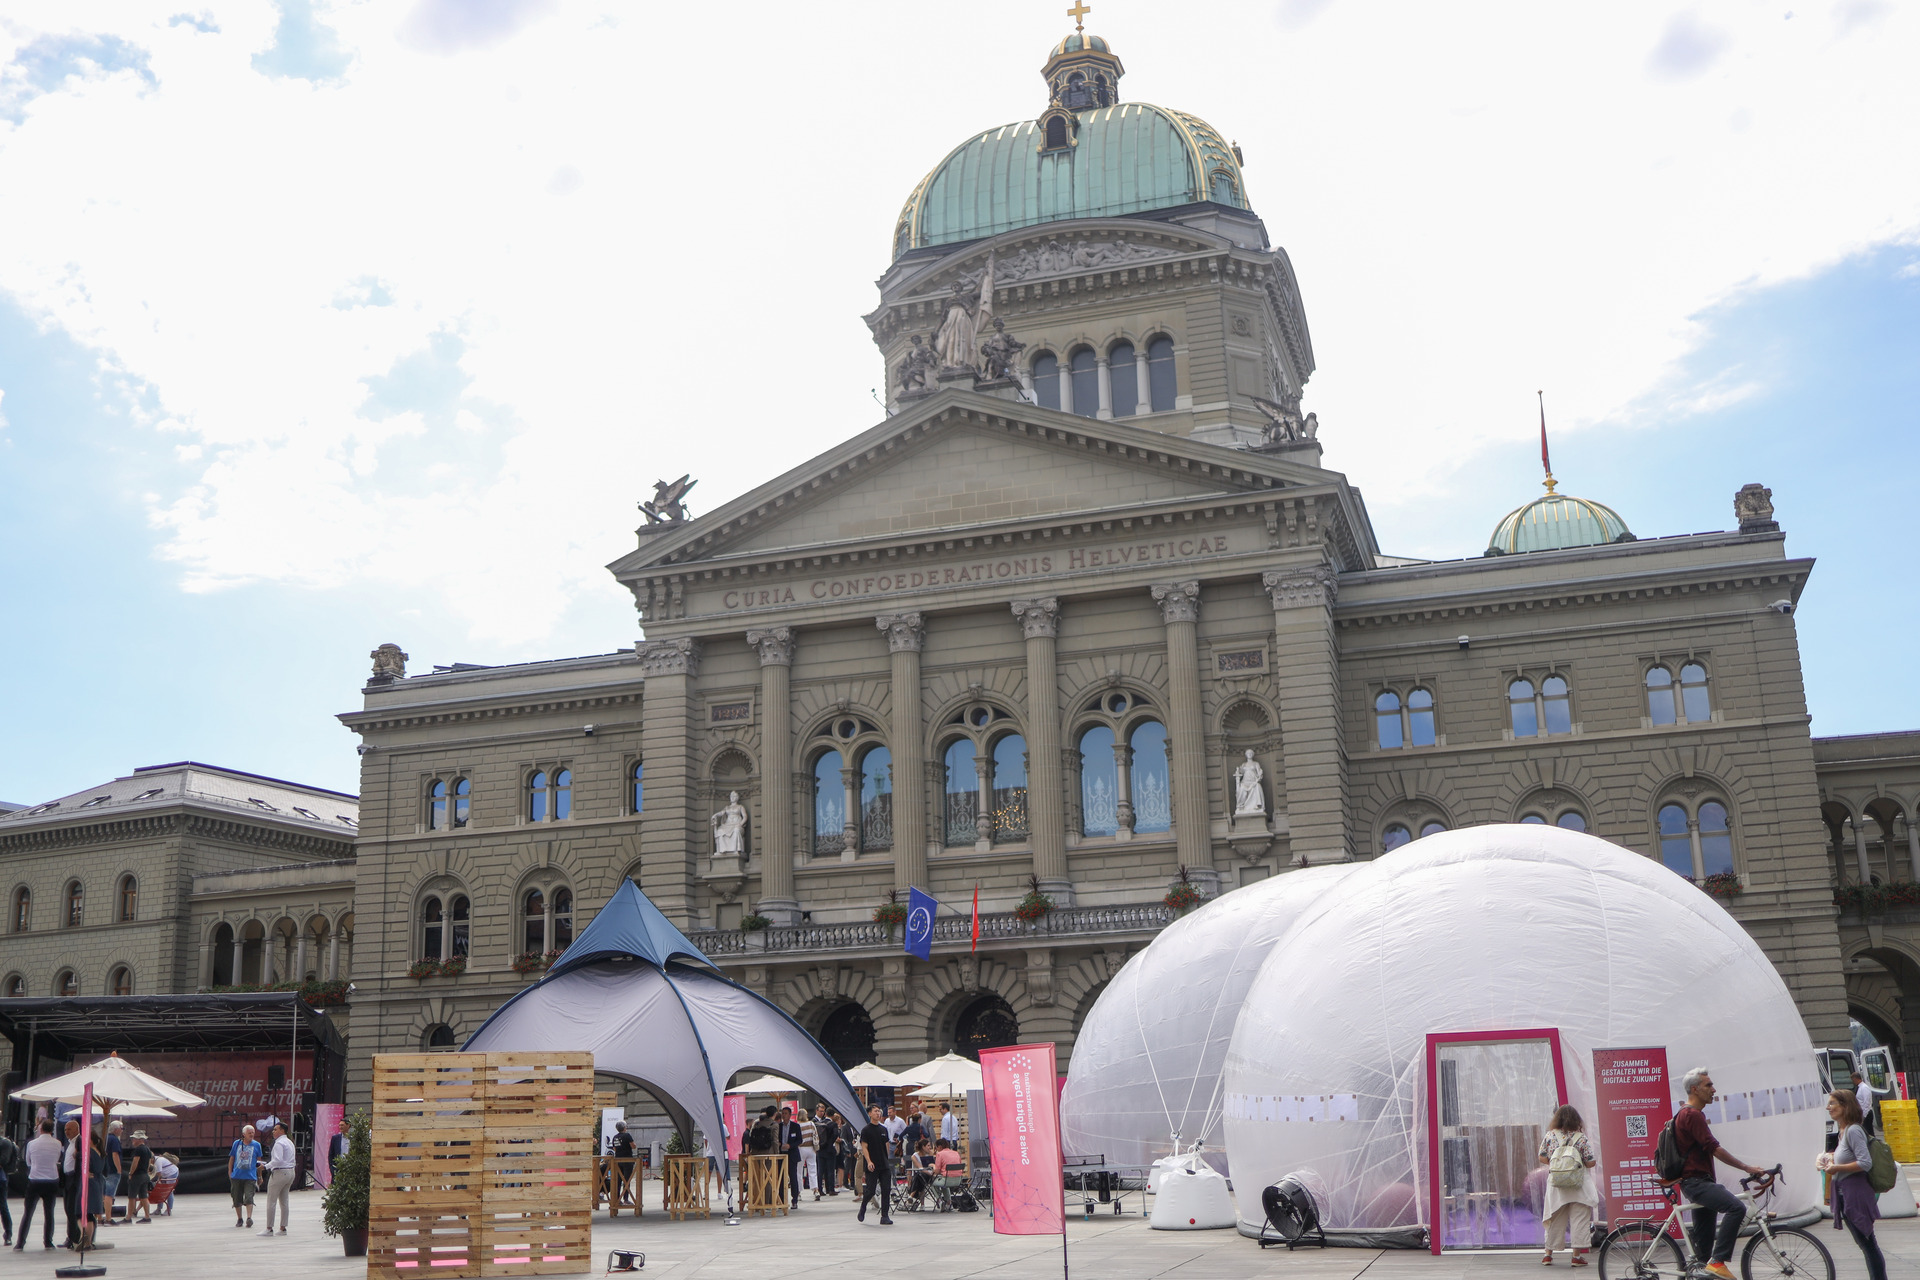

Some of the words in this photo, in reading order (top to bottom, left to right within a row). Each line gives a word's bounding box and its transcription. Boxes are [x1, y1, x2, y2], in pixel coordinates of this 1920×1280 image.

[722, 587, 796, 609] CURIA
[809, 556, 1053, 599] CONFOEDERATIONIS
[1068, 535, 1228, 569] HELVETICAE
[1612, 1060, 1649, 1068] ZUSAMMEN
[1601, 1068, 1637, 1076] GESTALTEN
[1603, 1076, 1631, 1084] DIGITALE
[1632, 1075, 1662, 1083] ZUKUNFT
[243, 1079, 264, 1091] WE
[203, 1094, 255, 1107] DIGITAL
[259, 1093, 303, 1106] FUTUR
